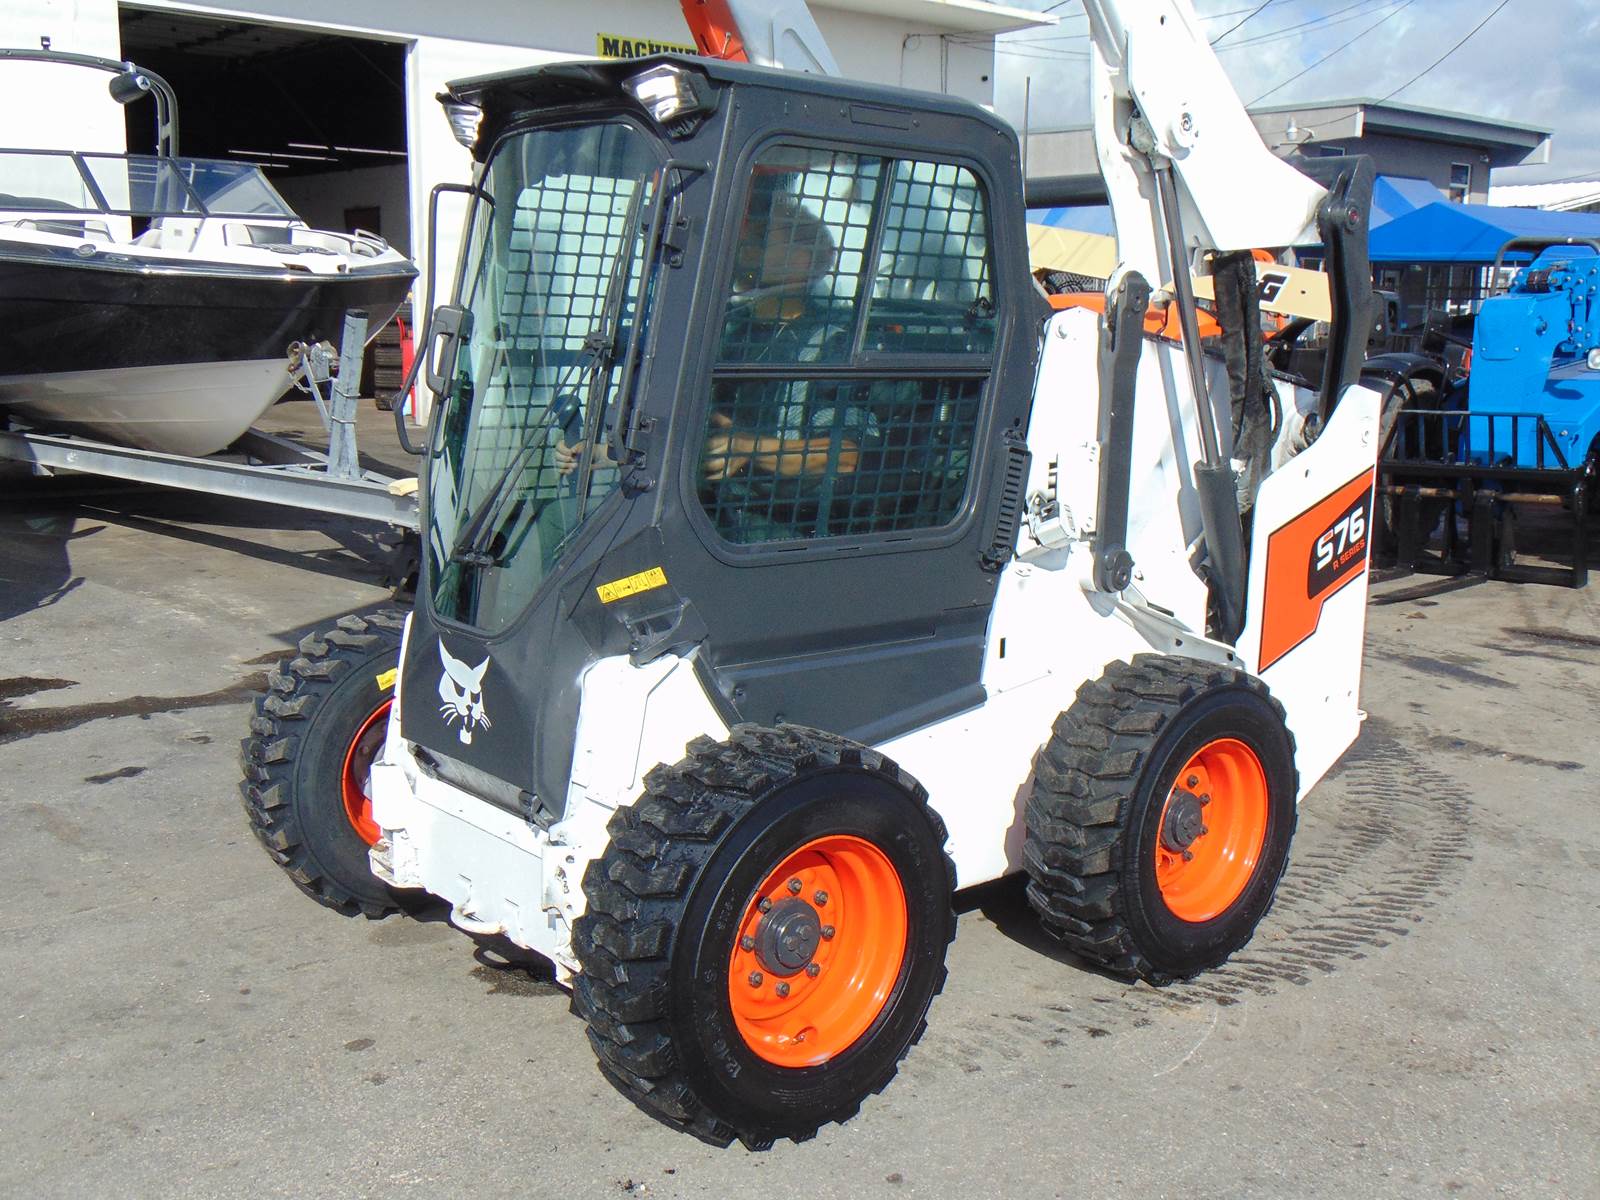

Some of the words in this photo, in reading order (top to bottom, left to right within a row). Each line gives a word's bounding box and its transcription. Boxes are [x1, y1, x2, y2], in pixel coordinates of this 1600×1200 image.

[1317, 505, 1365, 571] S76
[1332, 559, 1339, 572] R
[1340, 538, 1365, 565] SERIES
